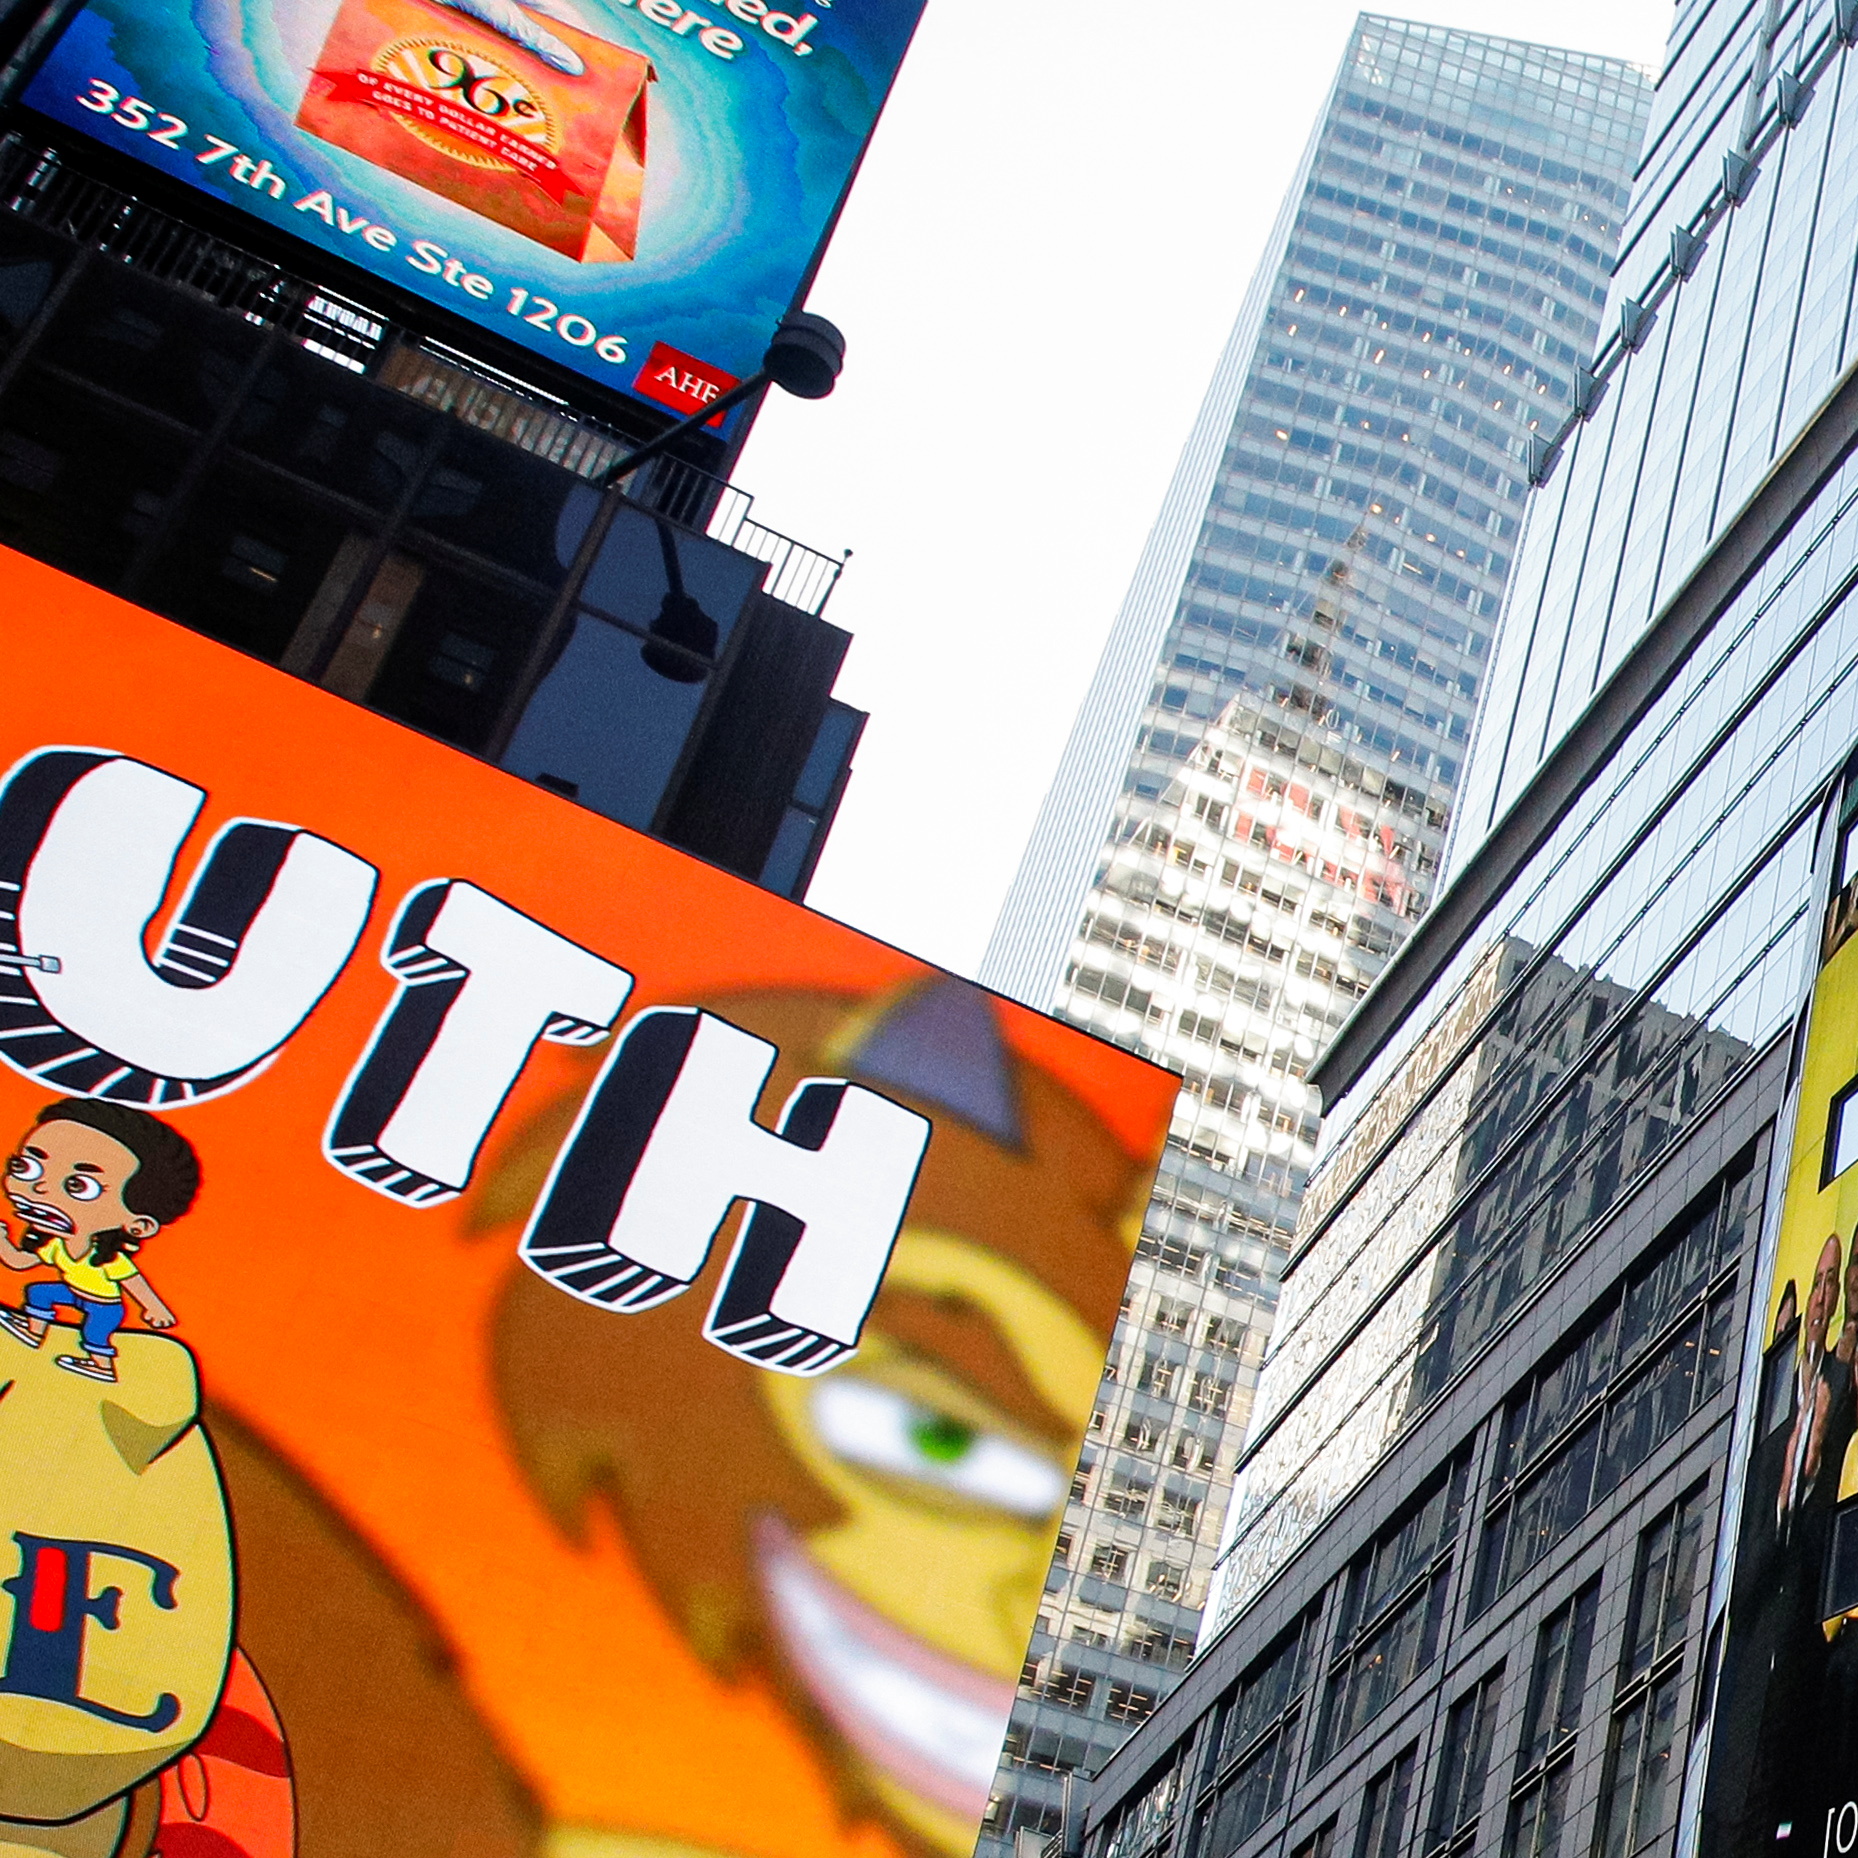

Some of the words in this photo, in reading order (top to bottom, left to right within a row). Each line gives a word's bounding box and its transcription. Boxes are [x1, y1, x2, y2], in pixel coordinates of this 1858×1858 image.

[623, 0, 743, 60] ere
[710, 0, 818, 56] ed,
[358, 74, 378, 87] OF
[383, 80, 433, 108] EVERY
[439, 103, 497, 137] DOLLAR
[500, 134, 557, 169] EARNED
[372, 90, 412, 112] GOES
[416, 107, 436, 122] TO
[440, 117, 497, 149] PATIENT
[500, 146, 540, 172] CARE
[76, 78, 188, 150] 352
[195, 134, 286, 200] 7th
[294, 190, 397, 251] Ave
[406, 239, 494, 300] Ste
[507, 287, 629, 364] 1206
[655, 365, 720, 403] AHF
[0, 745, 932, 1376] UTH
